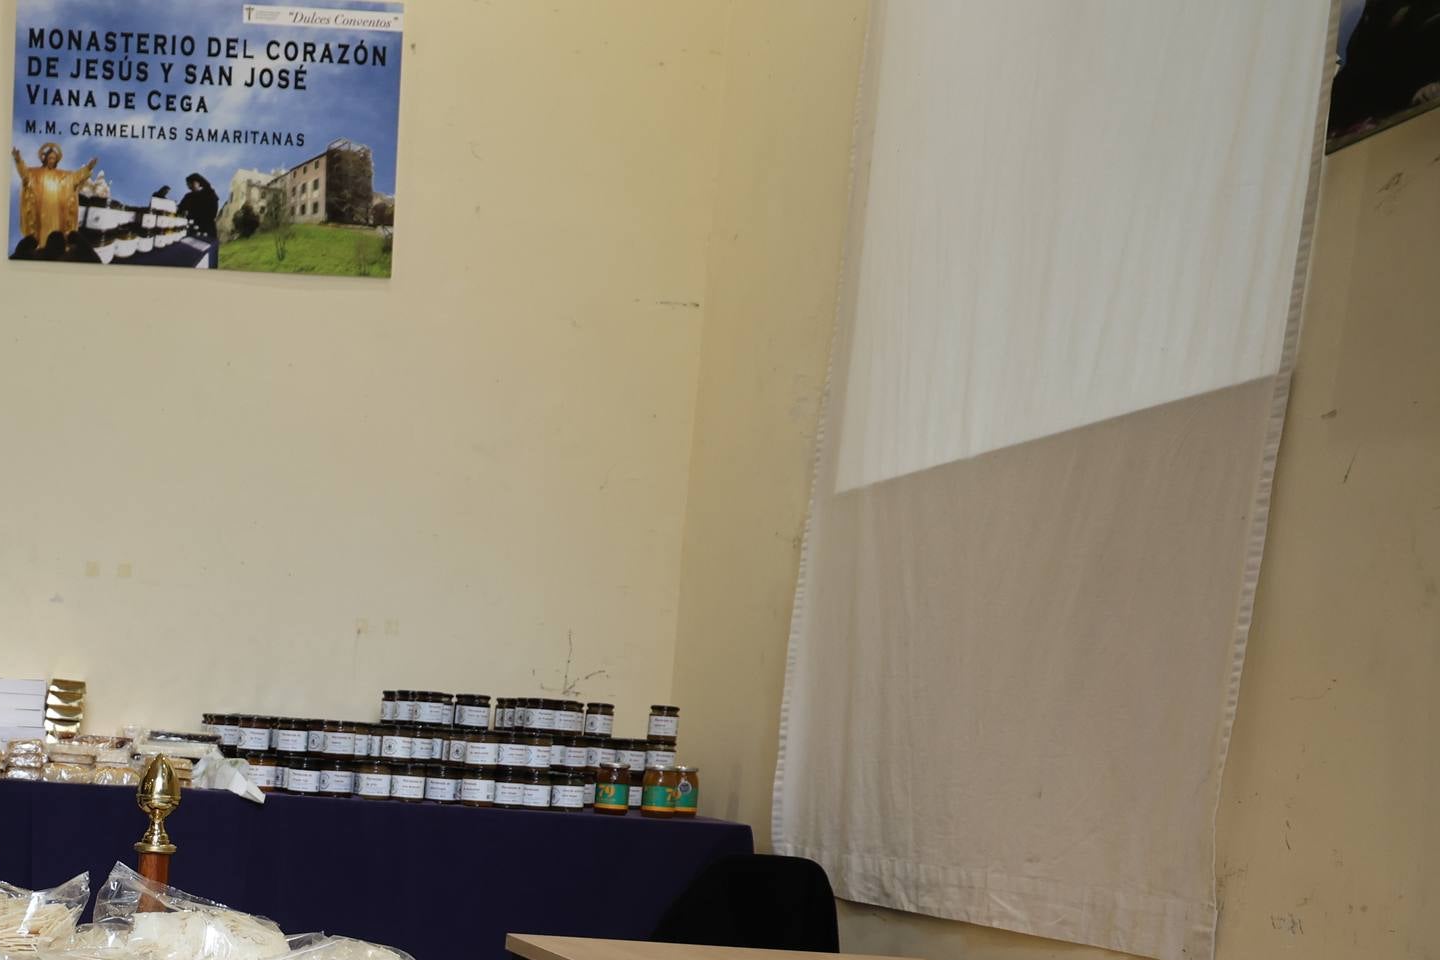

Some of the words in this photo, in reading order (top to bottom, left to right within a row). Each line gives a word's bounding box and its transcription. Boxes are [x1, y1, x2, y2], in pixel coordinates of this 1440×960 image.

[289, 11, 330, 25] "Dulces
[334, 14, 399, 28] Conventos"
[27, 28, 196, 57] MONASTERIO
[207, 37, 254, 59] DEL
[266, 39, 388, 66] CORAZÓN
[27, 56, 58, 78] DE
[70, 54, 149, 82] JESÚS
[160, 63, 173, 83] Y
[184, 64, 233, 86] SAN
[244, 65, 308, 90] JOSÉ
[25, 120, 62, 135] M.M.
[70, 122, 177, 140] CARMELITAS
[185, 128, 305, 146] SAMARITANAS
